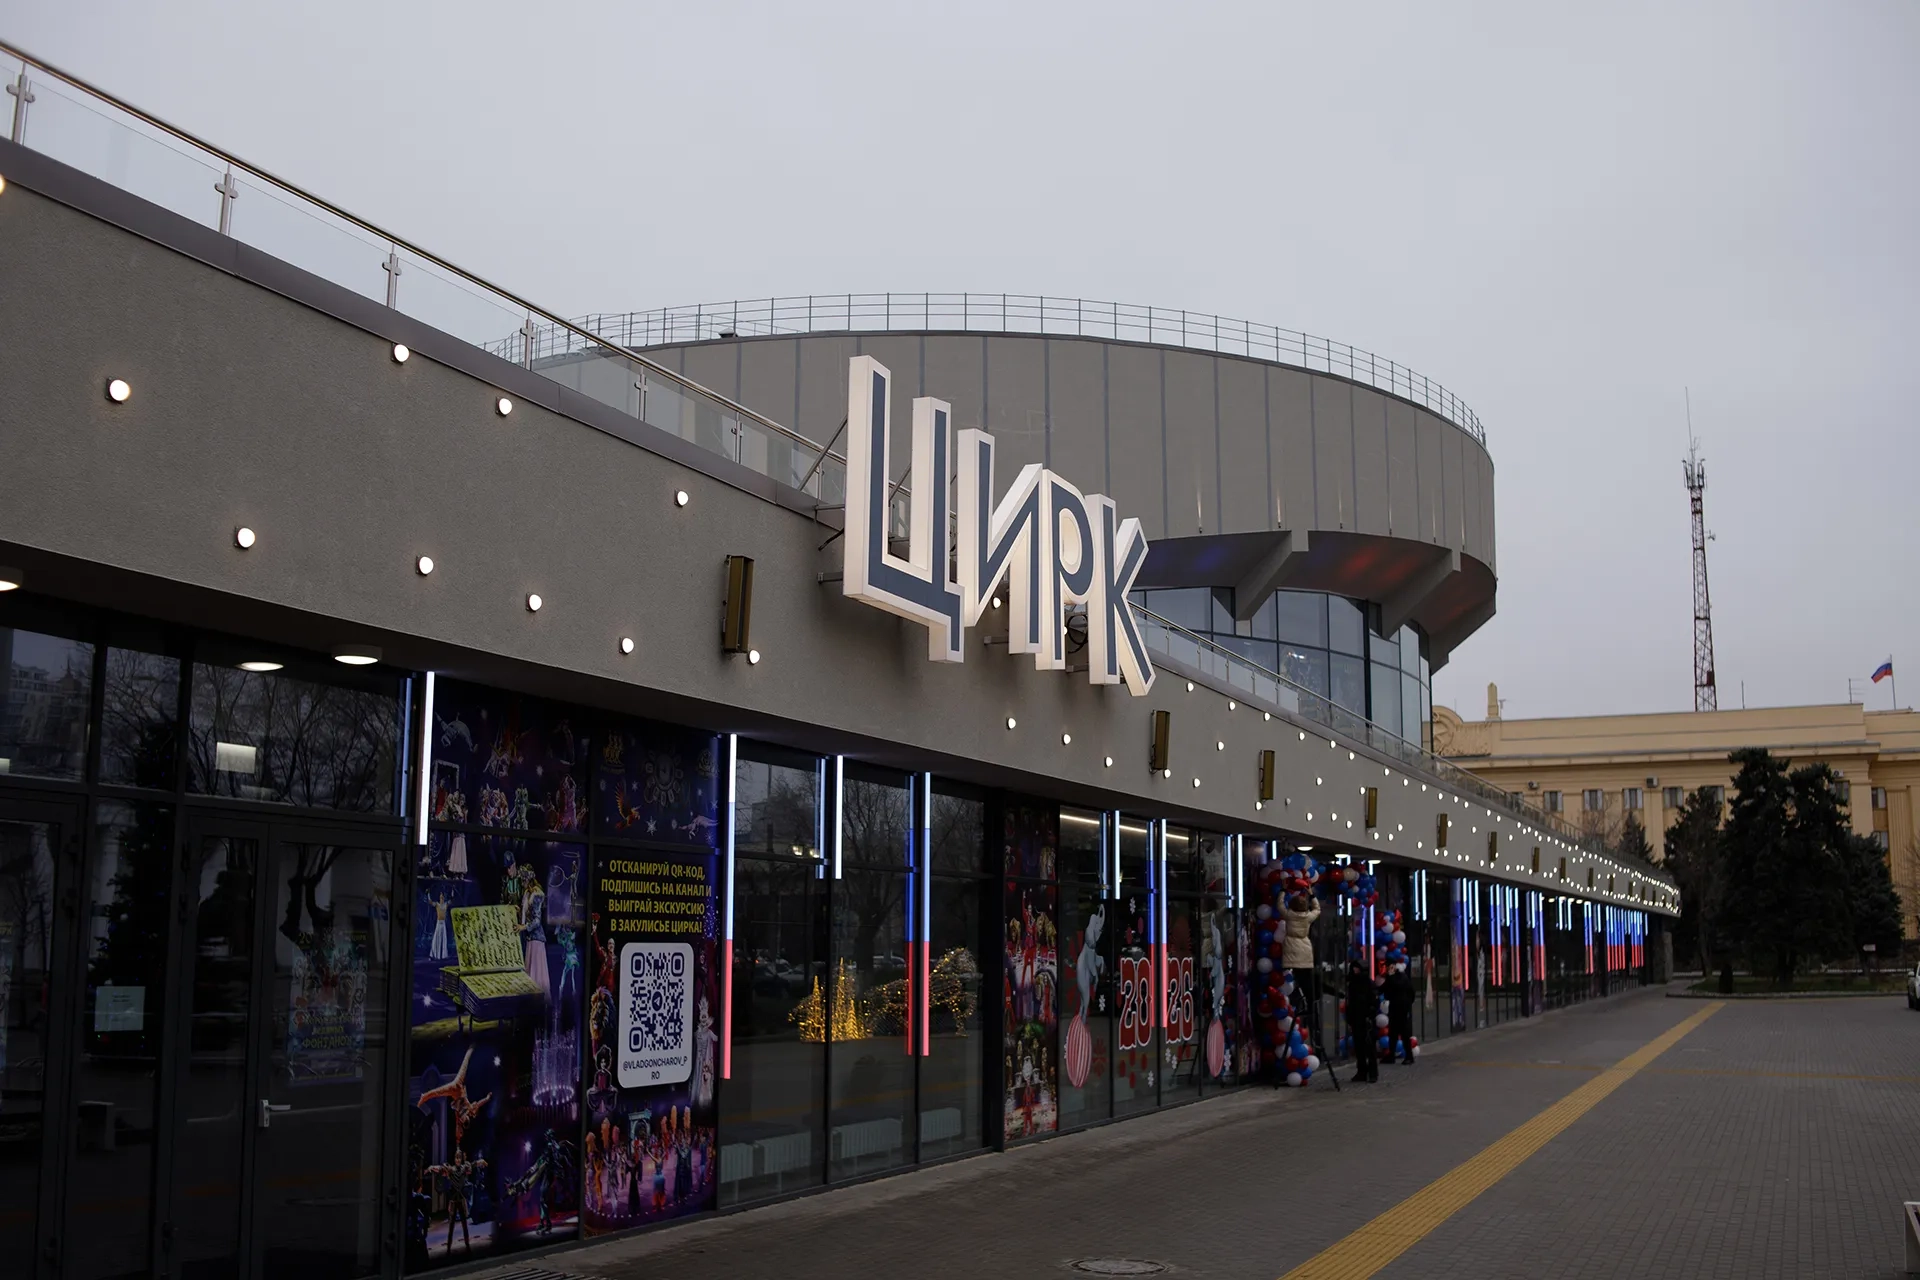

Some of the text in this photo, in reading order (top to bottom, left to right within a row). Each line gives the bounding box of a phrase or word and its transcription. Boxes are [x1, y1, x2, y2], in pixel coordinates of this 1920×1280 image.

[843, 355, 1156, 696] ЦИРК
[609, 859, 706, 881] ОТСКАНИРУЙ QR-КОД,
[601, 878, 712, 897] ПОДПИШИСЬ НА КАНАЛ И
[608, 898, 705, 915] ВЫИГРАЙ ЭКСКУРСИЮ
[610, 919, 703, 935] В ЗАКУЛИСЬЕ ЦИРКА!
[623, 1056, 688, 1071] @VLADGONCHAROV_P
[651, 1071, 660, 1080] RO
